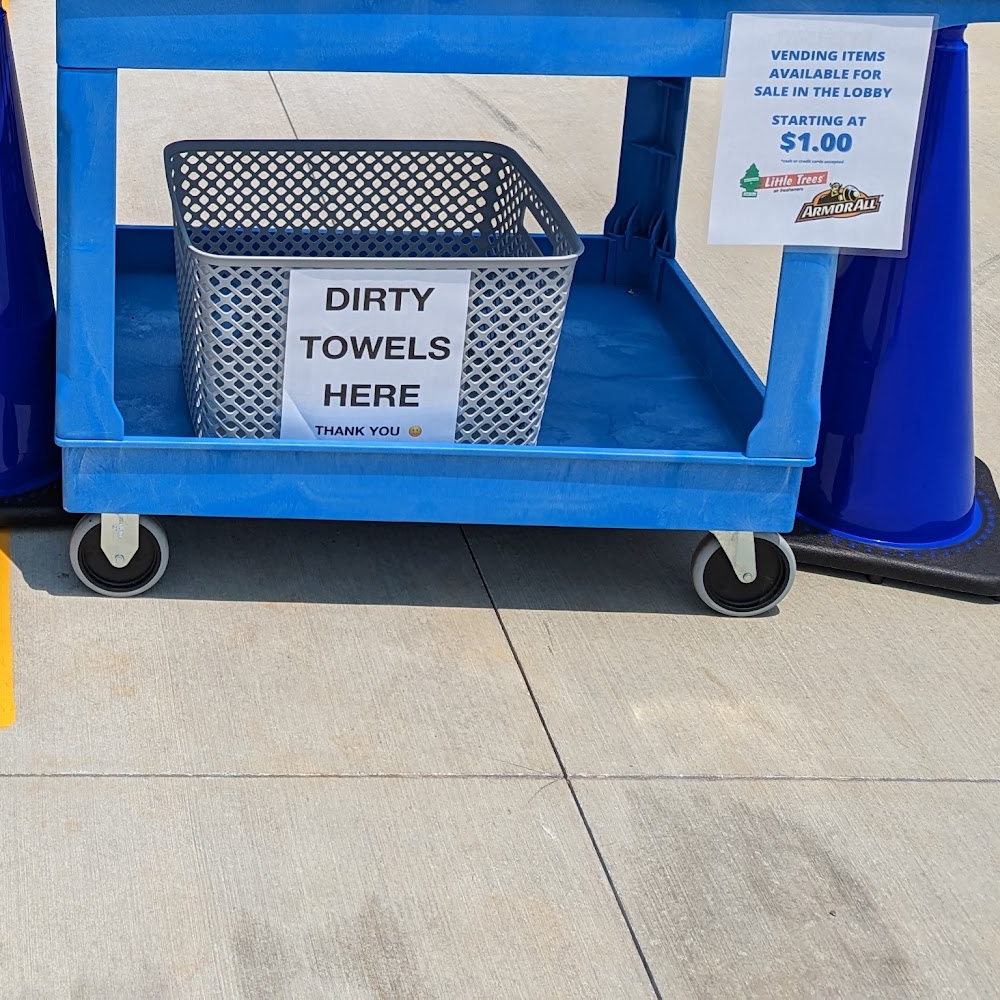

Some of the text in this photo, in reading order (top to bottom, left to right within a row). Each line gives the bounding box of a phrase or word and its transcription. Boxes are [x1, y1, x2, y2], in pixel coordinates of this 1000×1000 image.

[771, 50, 886, 62] VENDING ITEMS
[769, 68, 881, 80] AVAILABLE FOR
[754, 86, 893, 98] SALE IN THE LOBBY
[772, 115, 867, 126] STARTING AT
[780, 131, 852, 153] $1.00
[765, 174, 824, 187] Little Trees
[325, 287, 435, 311] DIRTY
[300, 335, 451, 360] TOWELS
[323, 383, 421, 407] HERE
[315, 425, 400, 436] THANK YOU
